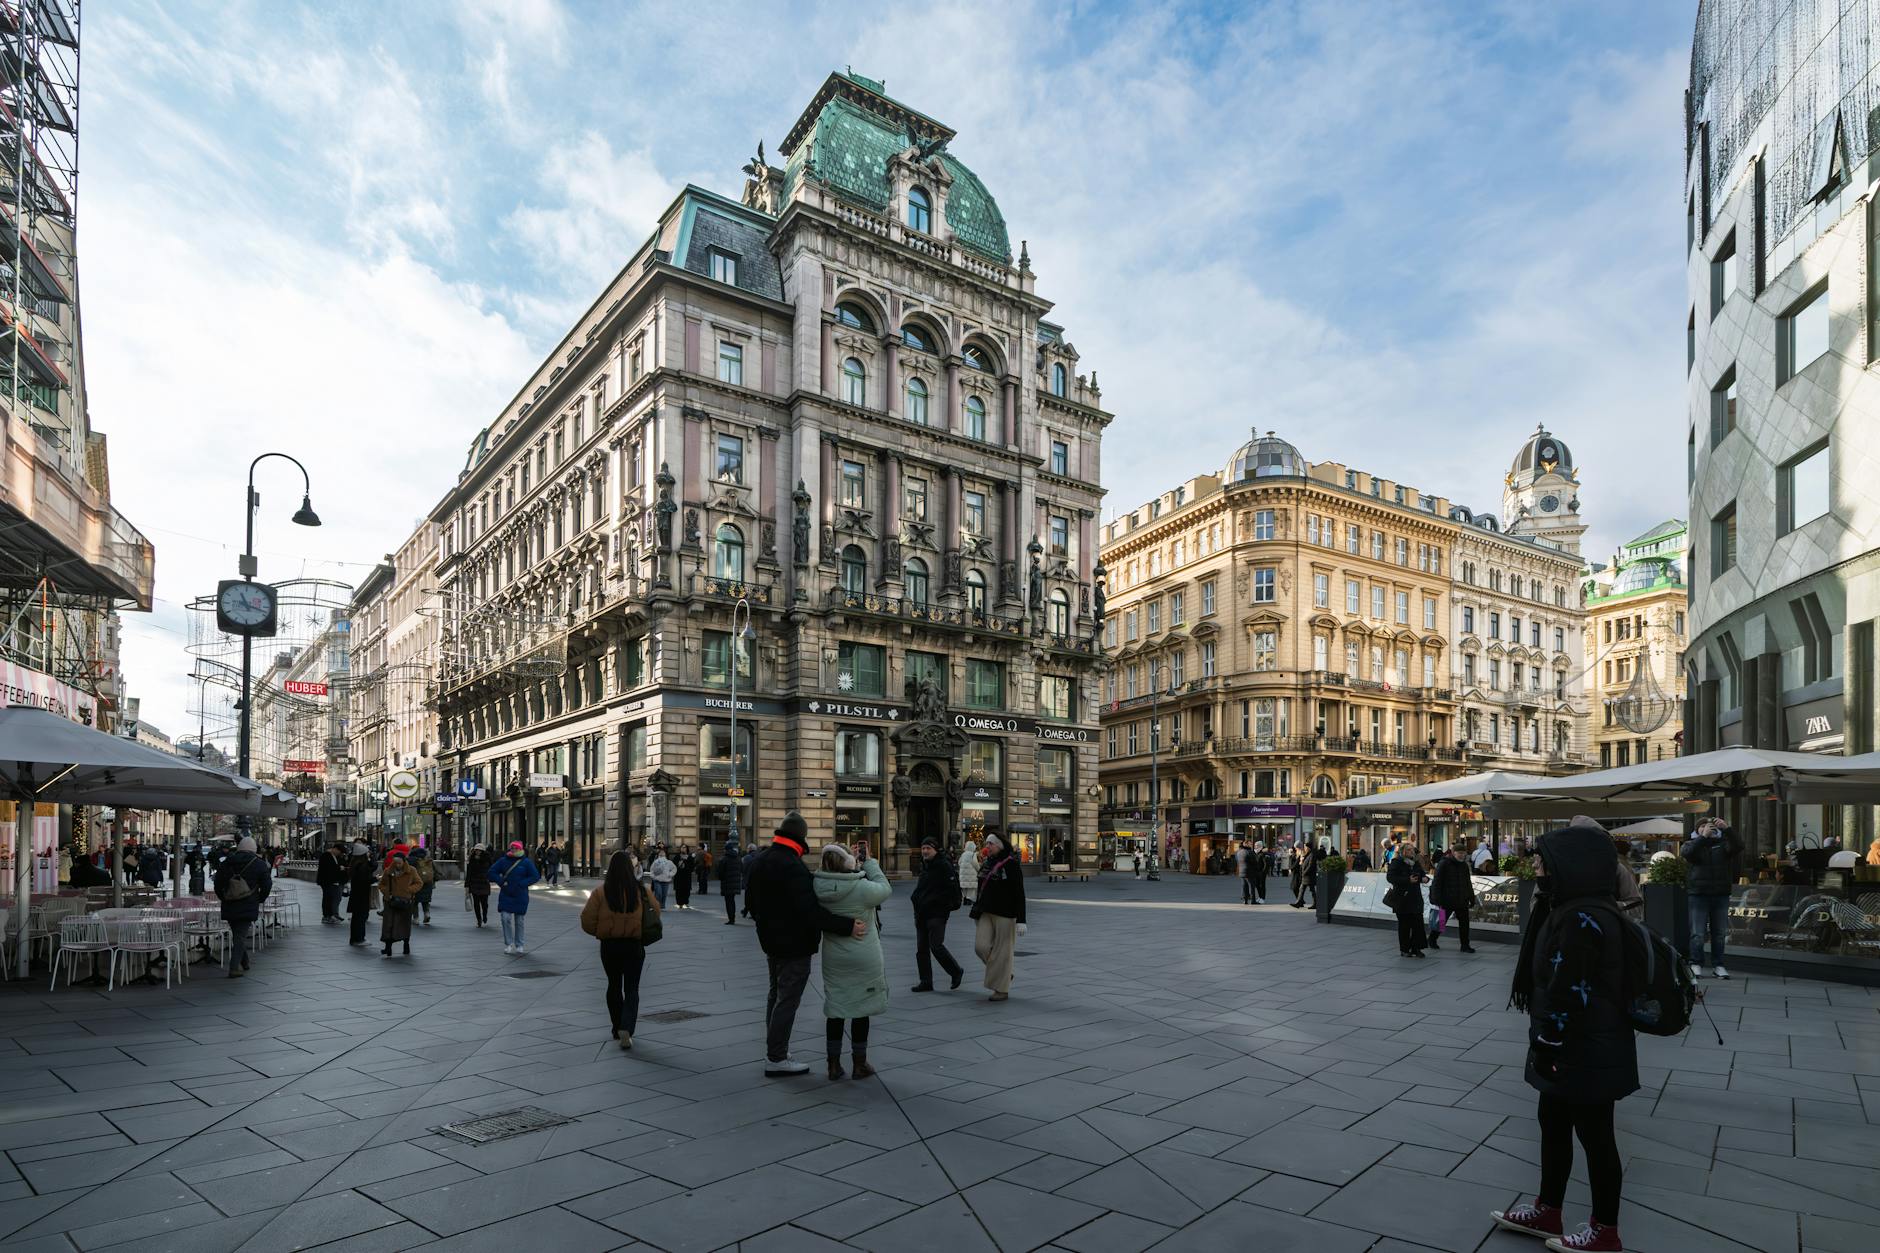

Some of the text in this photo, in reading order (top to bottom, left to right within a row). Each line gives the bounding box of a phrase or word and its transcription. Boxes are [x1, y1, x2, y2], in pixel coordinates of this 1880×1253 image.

[286, 682, 323, 694] HUBER
[705, 699, 753, 710] BUCHRER
[826, 704, 883, 718] PILSTL
[968, 718, 1004, 730] OMEGA
[1805, 715, 1832, 734] ZARA
[1044, 729, 1076, 740] OMEGA
[462, 781, 475, 794] U
[1343, 886, 1367, 894] DEMEL
[1484, 893, 1519, 903] DEMEL
